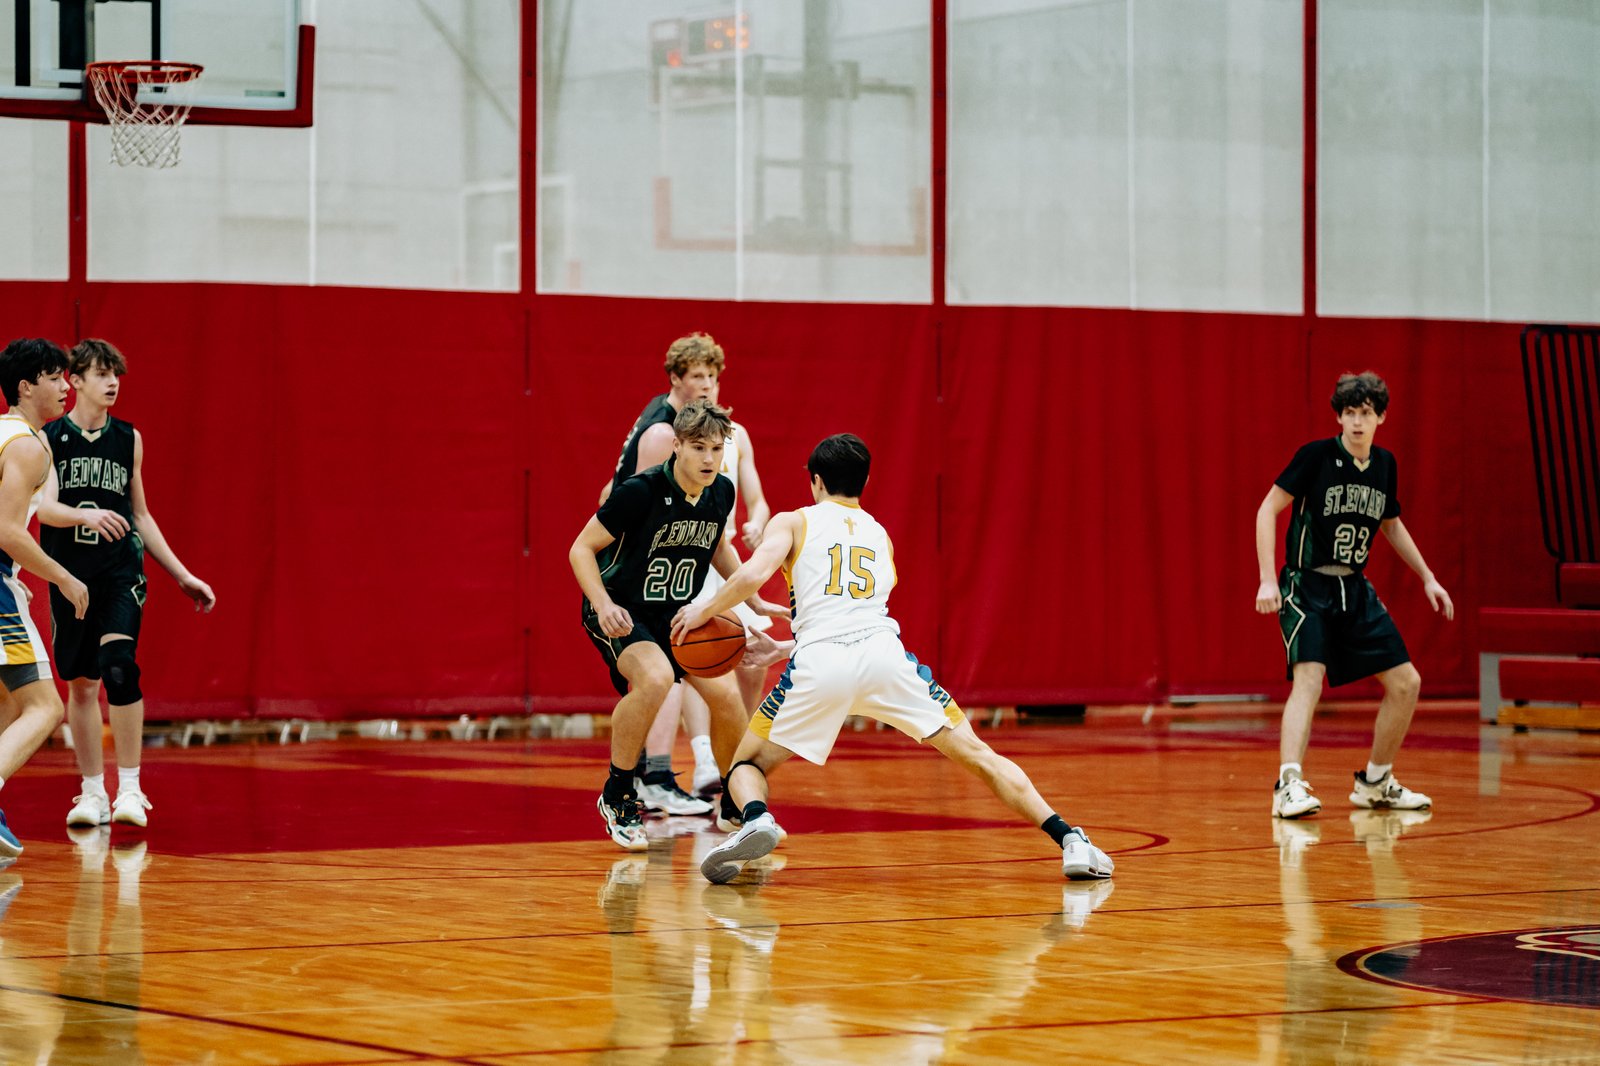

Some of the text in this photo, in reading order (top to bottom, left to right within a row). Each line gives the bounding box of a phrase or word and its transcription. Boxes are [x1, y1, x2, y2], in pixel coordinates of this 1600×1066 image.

[58, 457, 128, 496] T.EDWARD
[1333, 523, 1370, 564] 23
[643, 557, 697, 601] 20
[824, 543, 876, 599] 15
